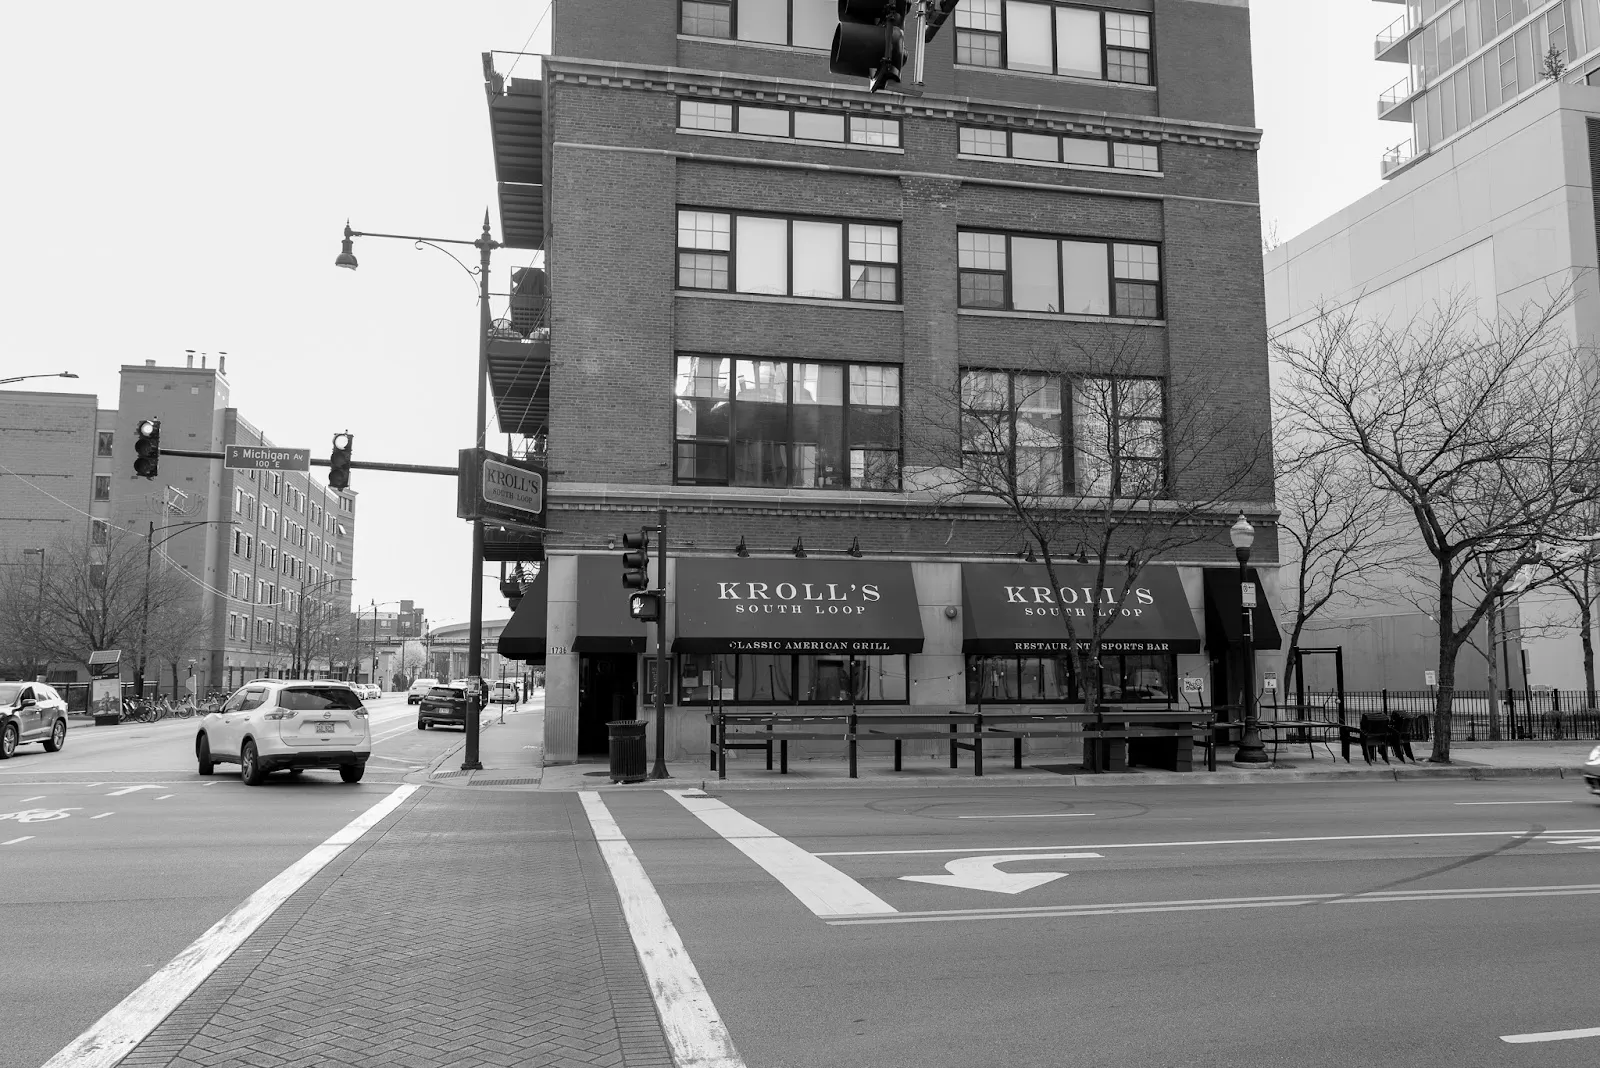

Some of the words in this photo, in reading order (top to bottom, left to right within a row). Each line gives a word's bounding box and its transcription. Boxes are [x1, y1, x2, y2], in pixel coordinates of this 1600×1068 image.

[232, 450, 238, 458] S
[242, 449, 290, 462] Michigan
[487, 468, 539, 494] KROLL'S
[493, 488, 514, 500] SOUTH
[516, 494, 533, 504] LOOP
[717, 582, 881, 602] KROLL'S
[735, 604, 802, 614] SOUTH
[815, 605, 866, 615] LOOP
[729, 641, 781, 650] CLASSIC
[784, 641, 848, 650] AMERICAN
[852, 642, 890, 651] GRILL
[1014, 642, 1091, 651] RESTAURNT
[1101, 642, 1144, 651] SPORTS
[1147, 643, 1169, 651] BAR
